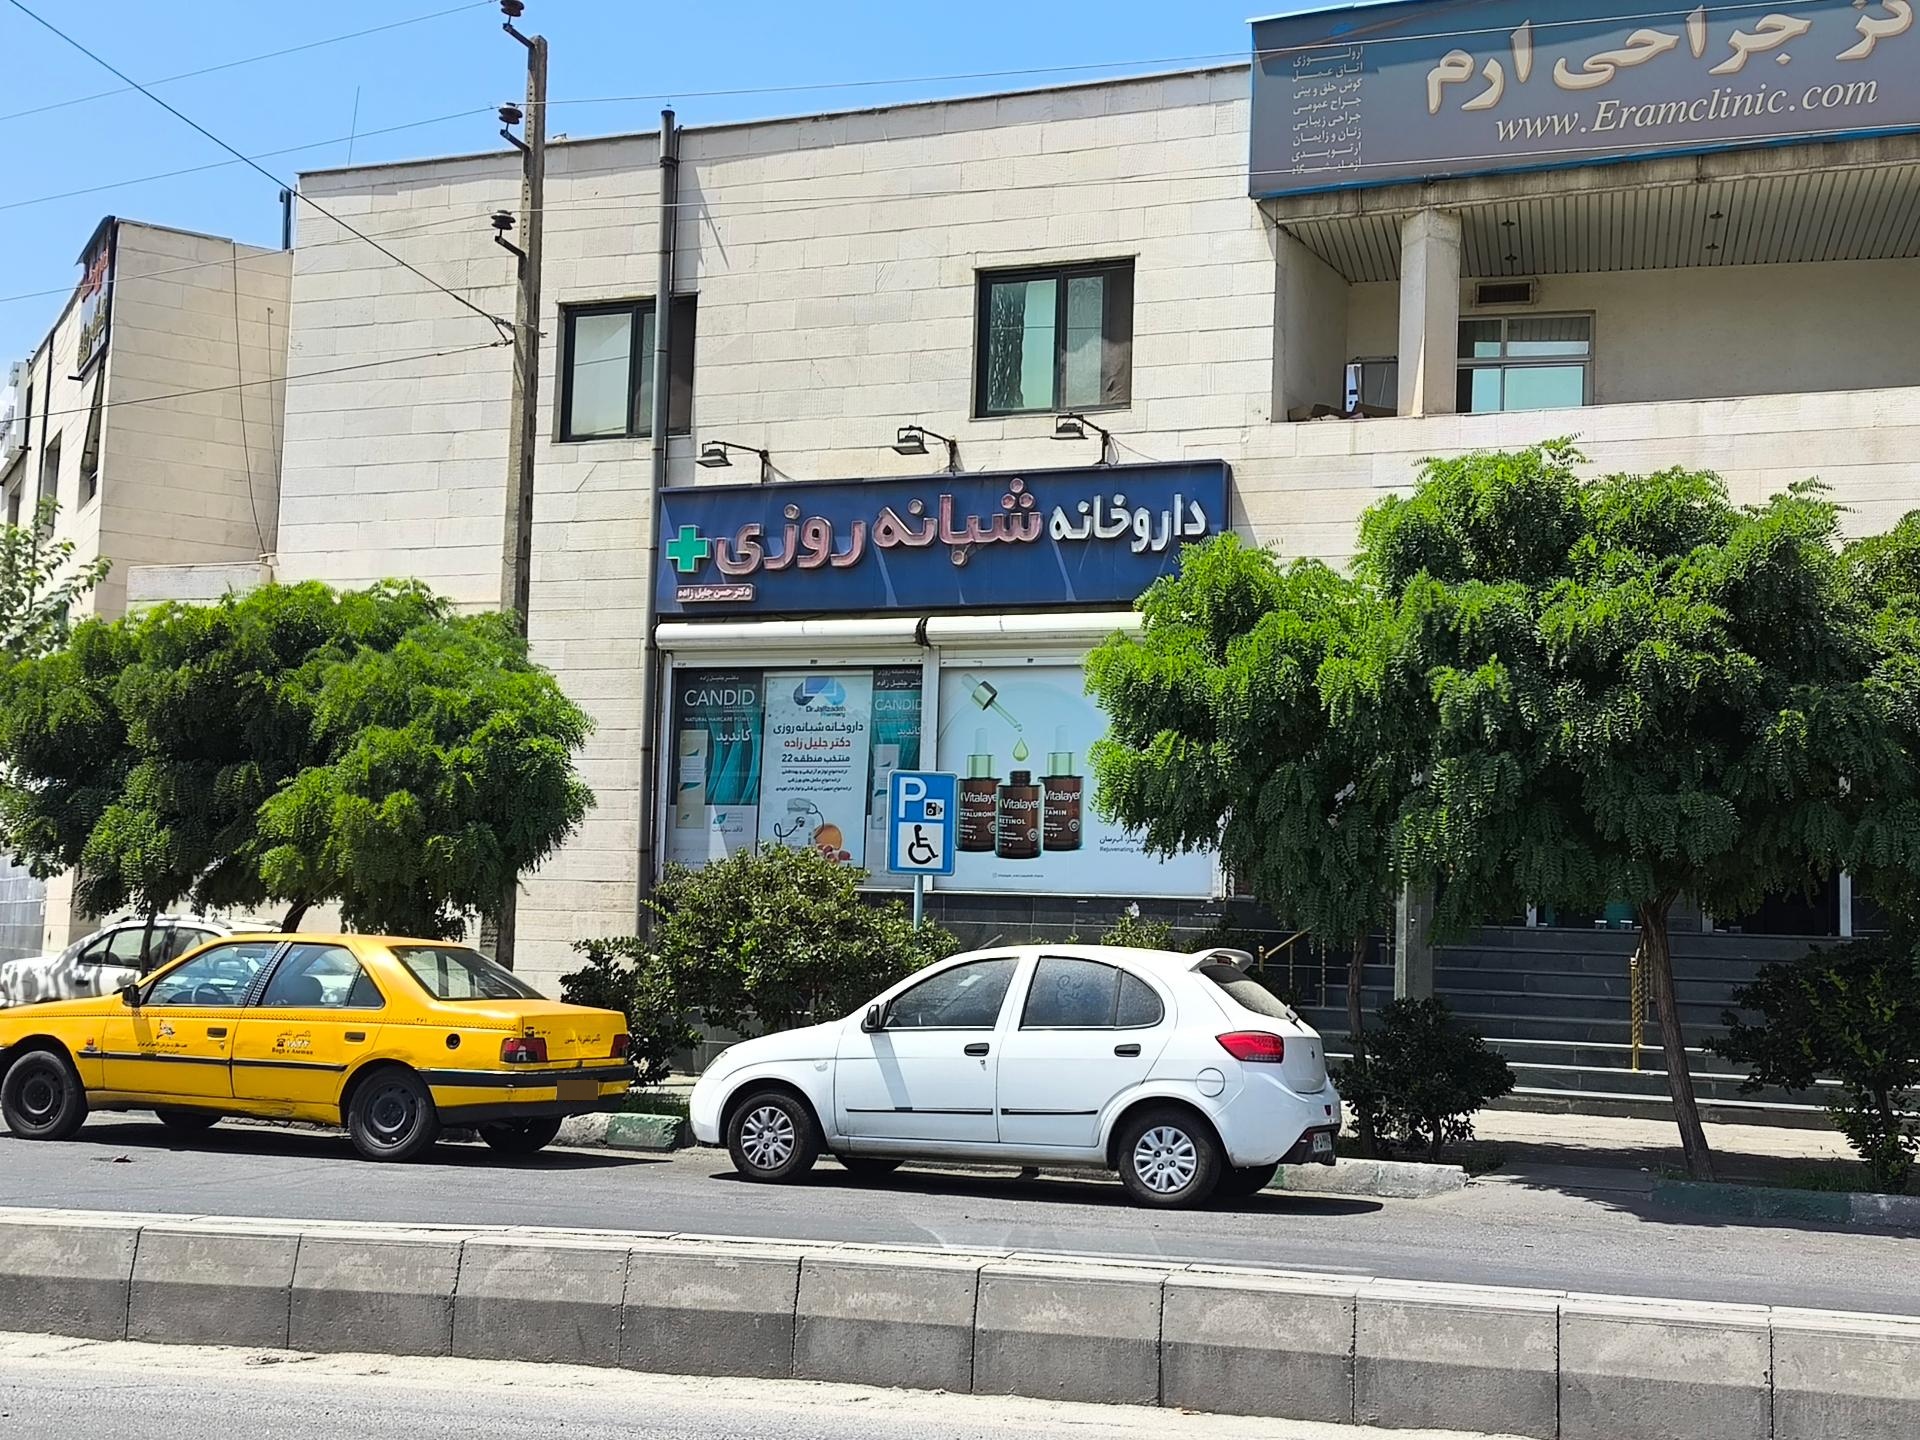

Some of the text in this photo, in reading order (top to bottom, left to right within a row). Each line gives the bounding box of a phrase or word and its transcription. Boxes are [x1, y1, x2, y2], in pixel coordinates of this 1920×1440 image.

[1553, 4, 1813, 90] جراحی
[1292, 61, 1363, 82] اتاق عمل
[1426, 18, 1534, 115] ارم
[1293, 78, 1362, 99] گوش حلق و بینی
[1293, 96, 1361, 115] جراح عمومی
[1495, 79, 1879, 142] www.Eramclinic.com
[1293, 111, 1361, 131] جراحی زیبایی
[1293, 127, 1361, 147] زنان و زایمان
[715, 477, 1208, 576] داروخانه شبانه روزی
[678, 587, 751, 600] دکتر حسن جلیل زاده
[684, 689, 755, 706] CANDID
[716, 728, 752, 745] کاندید
[773, 721, 864, 735] داروخانه شبانه روزی
[784, 737, 851, 750] دکتر جلیل زاده
[781, 753, 850, 764] منتخب منطقه 22
[899, 777, 927, 818] P
[964, 792, 996, 804] Vitalaye
